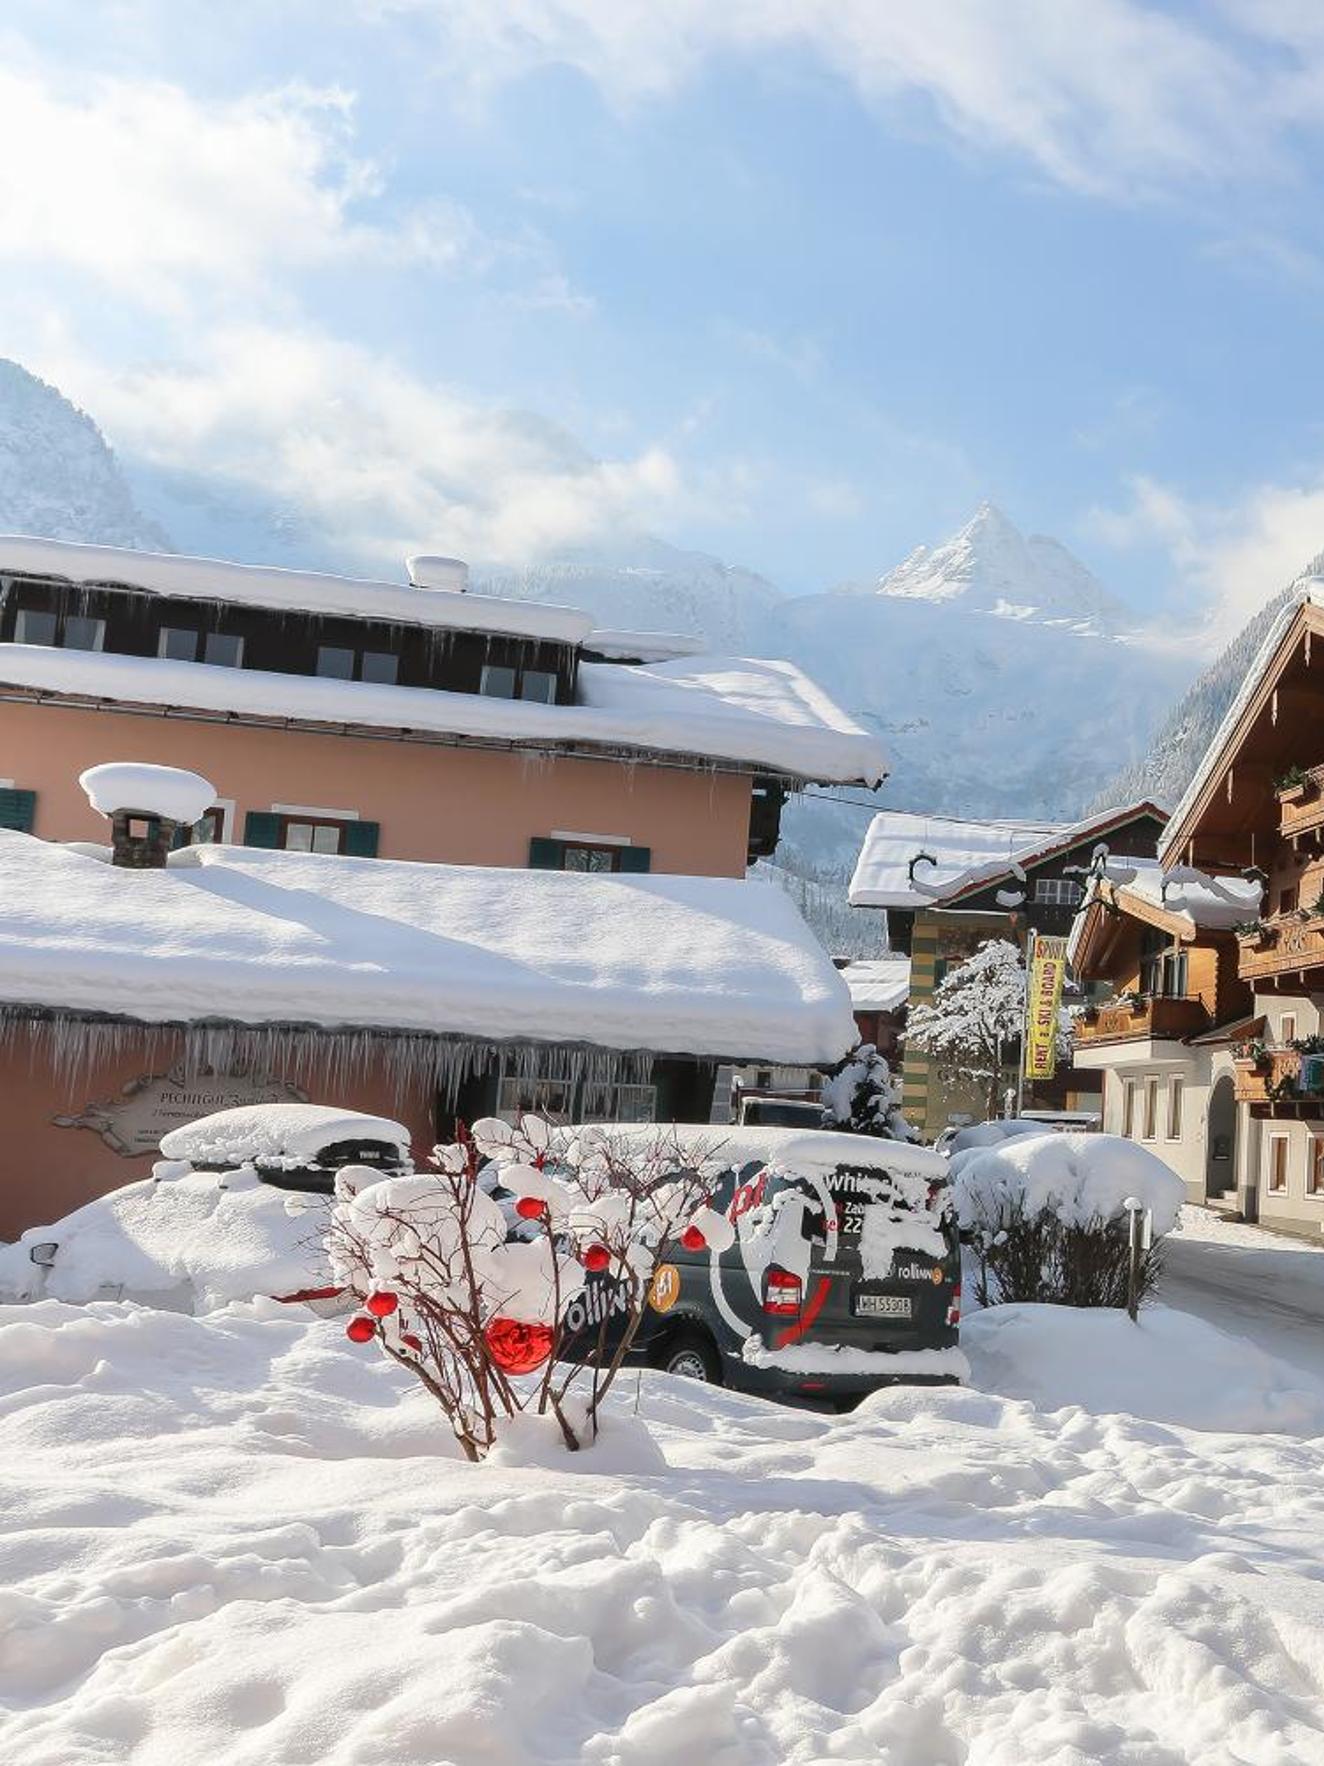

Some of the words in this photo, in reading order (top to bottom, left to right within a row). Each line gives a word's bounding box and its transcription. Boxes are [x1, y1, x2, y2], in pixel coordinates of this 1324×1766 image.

[1042, 962, 1057, 997] BOARD
[1037, 1010, 1051, 1026] SKI
[1034, 1044, 1050, 1069] RENT
